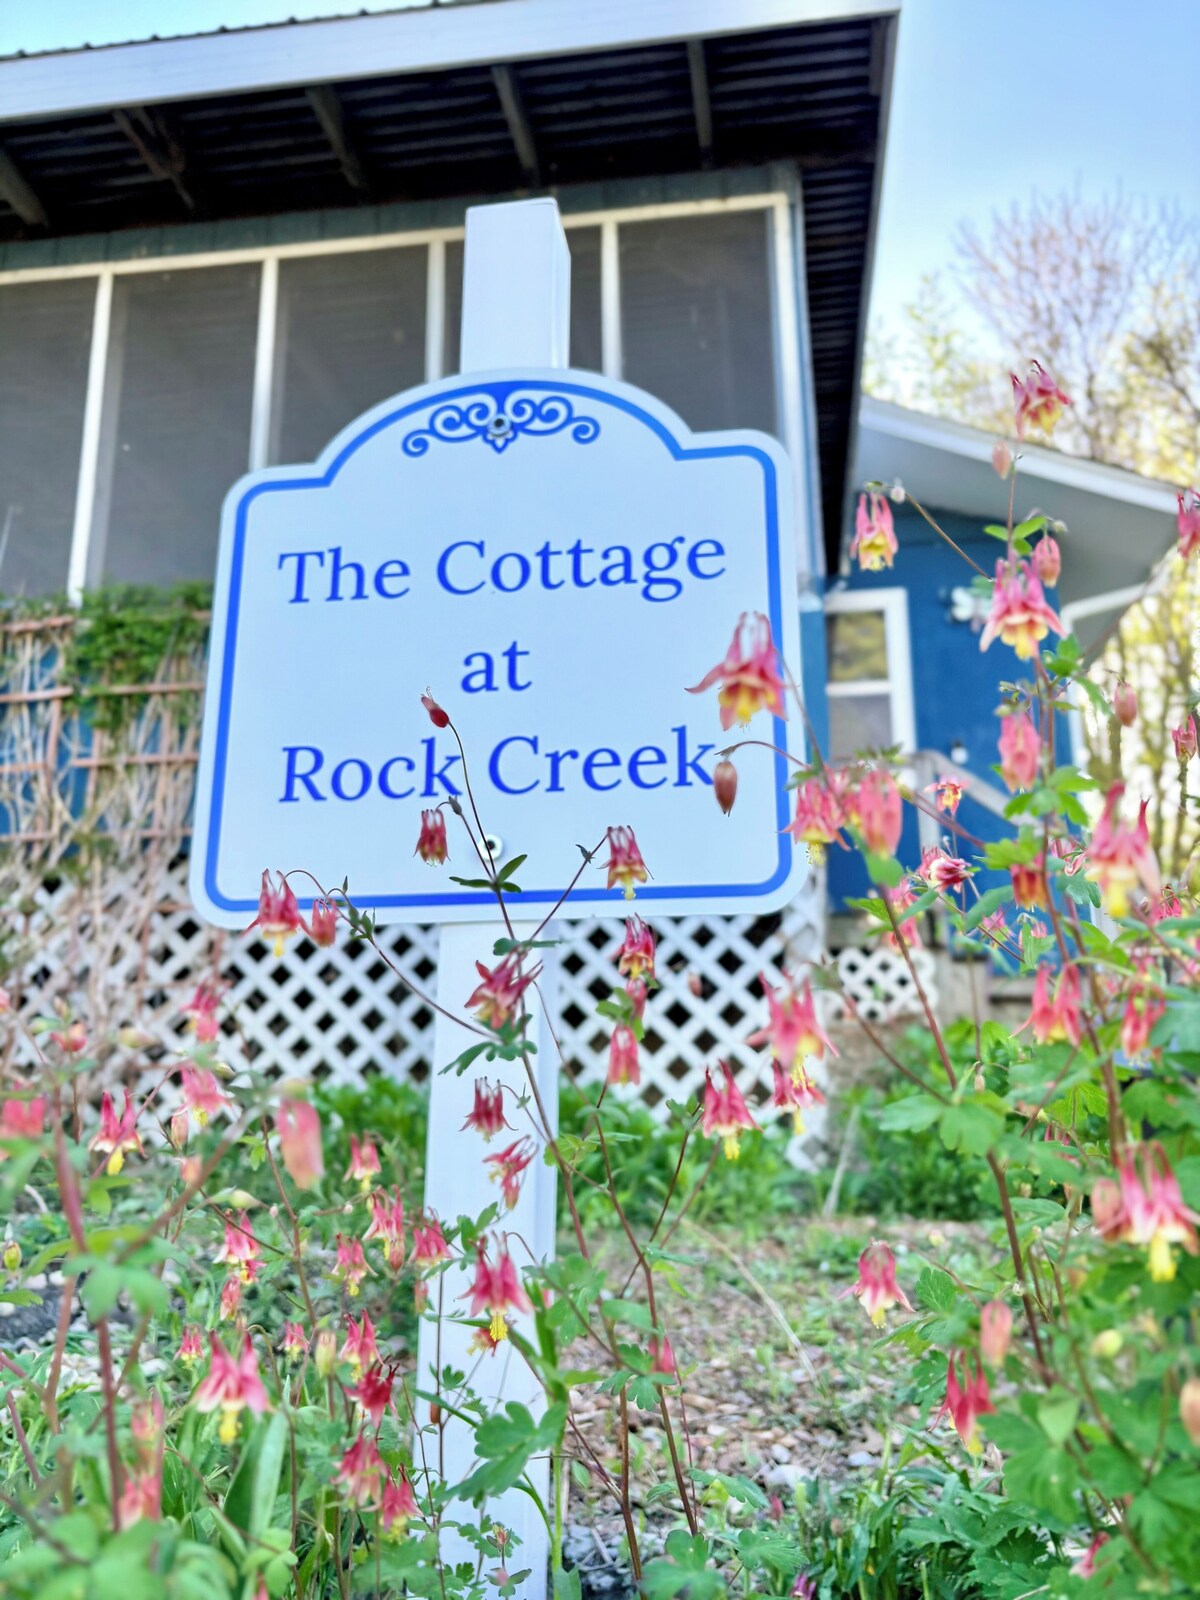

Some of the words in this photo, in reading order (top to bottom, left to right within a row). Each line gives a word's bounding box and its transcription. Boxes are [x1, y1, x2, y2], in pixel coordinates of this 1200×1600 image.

[277, 545, 412, 605] The
[436, 535, 727, 604] Cottage
[459, 640, 533, 695] at
[278, 736, 464, 803] Rock
[487, 724, 718, 796] Creek
